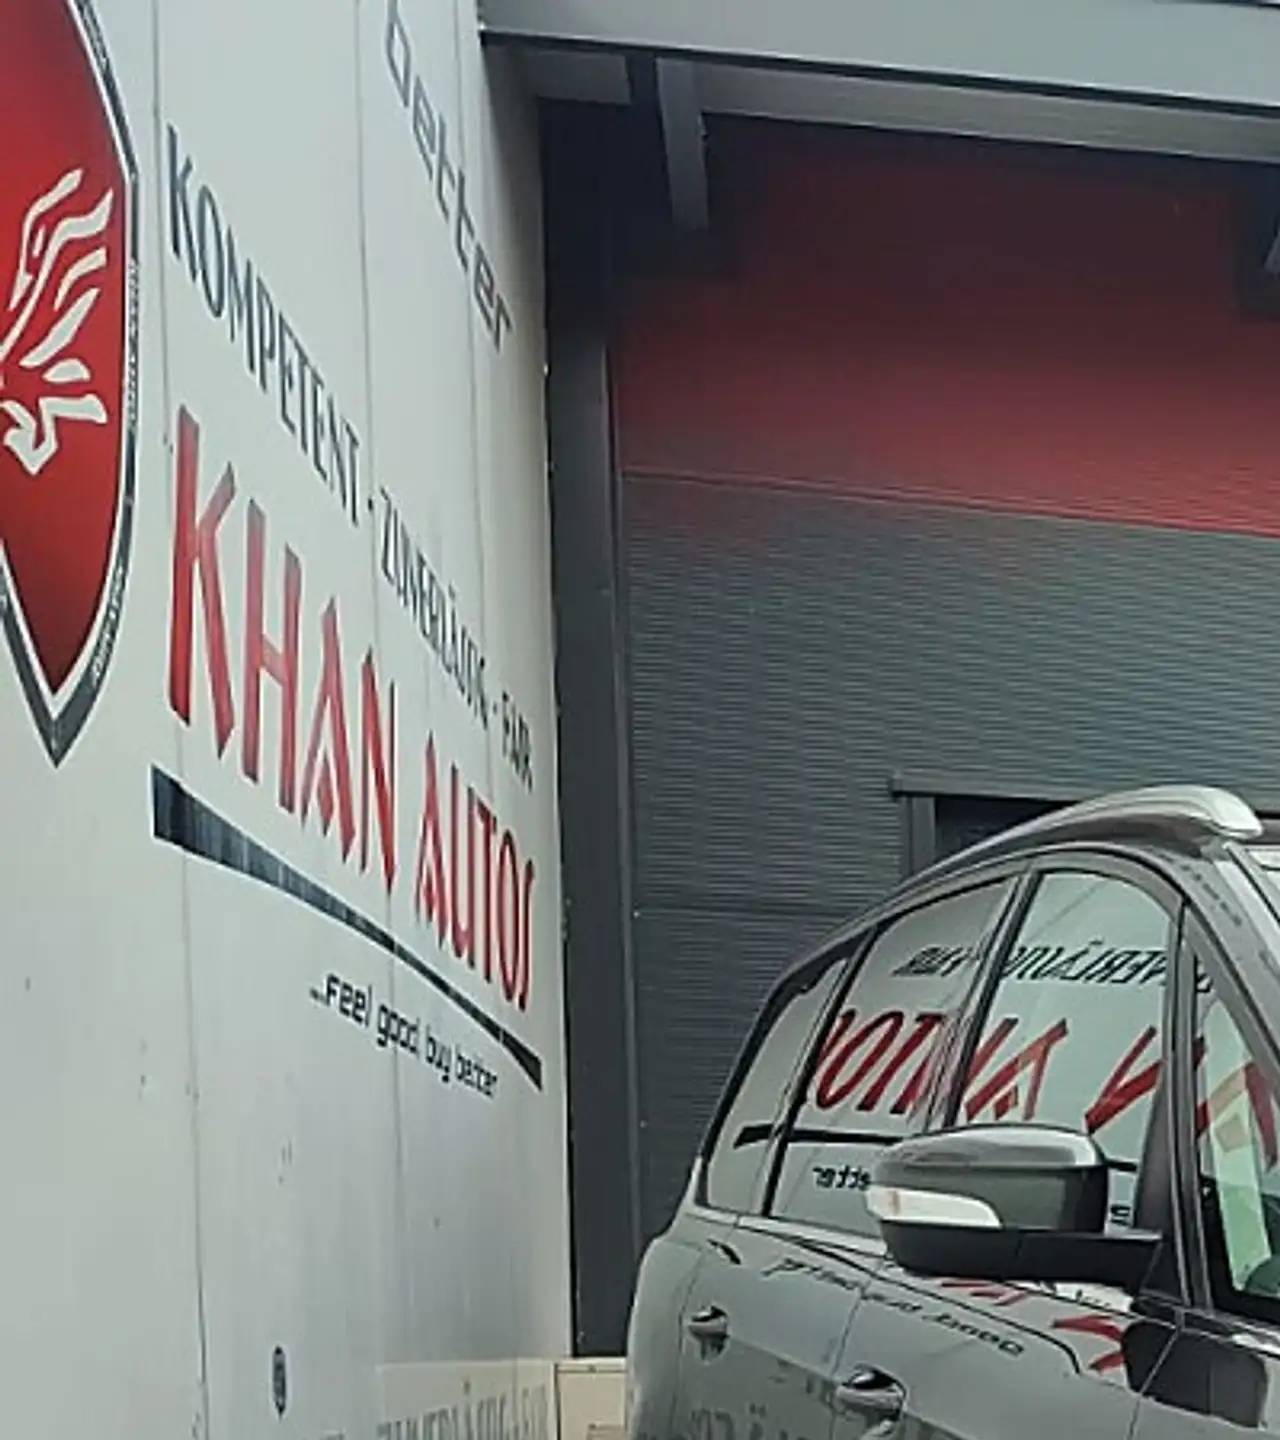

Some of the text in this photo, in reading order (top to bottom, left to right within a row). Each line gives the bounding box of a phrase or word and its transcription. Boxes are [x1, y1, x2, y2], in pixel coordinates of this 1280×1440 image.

[167, 122, 360, 527] KOMPETENT
[169, 403, 535, 1013] KHAN AUTOS
